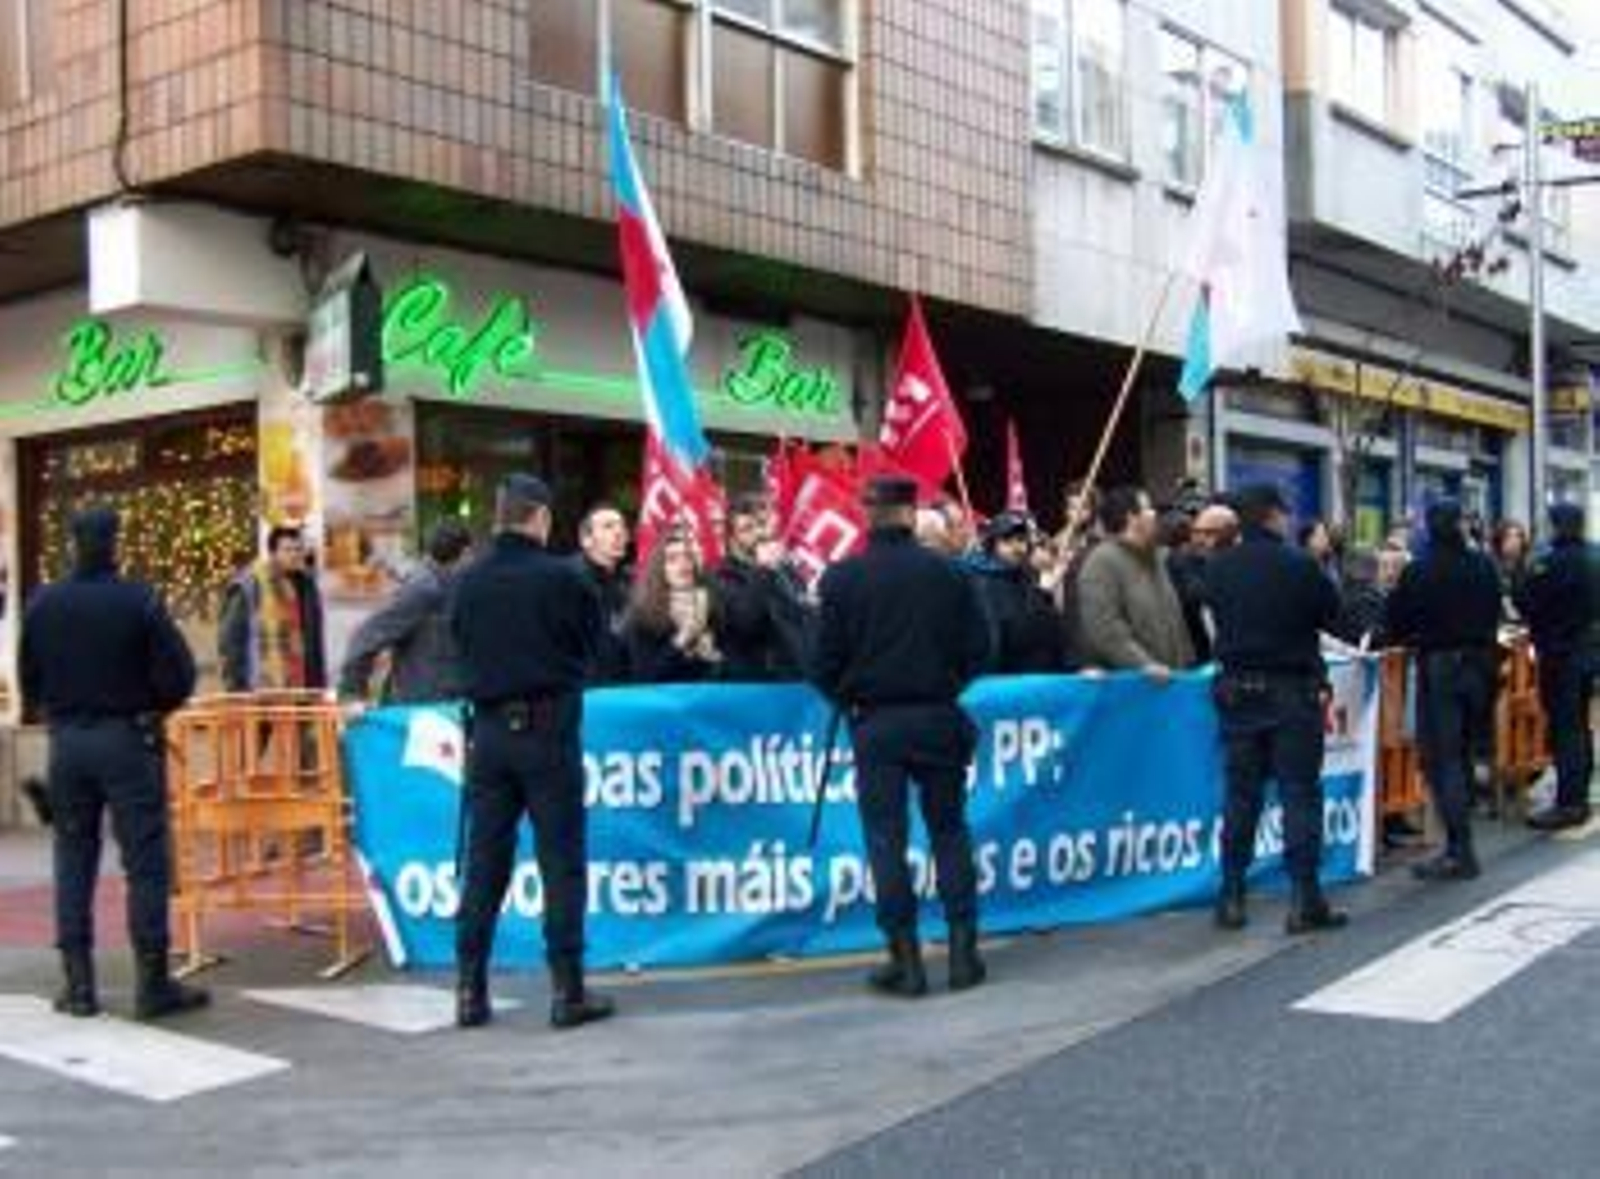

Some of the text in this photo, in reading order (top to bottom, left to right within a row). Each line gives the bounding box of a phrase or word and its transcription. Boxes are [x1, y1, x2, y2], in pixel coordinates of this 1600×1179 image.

[56, 320, 166, 406] Bar
[724, 332, 838, 415] Bar
[993, 717, 1062, 789] PP:
[395, 860, 461, 918] os
[684, 838, 814, 914] máis
[1009, 838, 1038, 890] e
[1048, 829, 1097, 884] os
[1104, 809, 1203, 877] ricos
